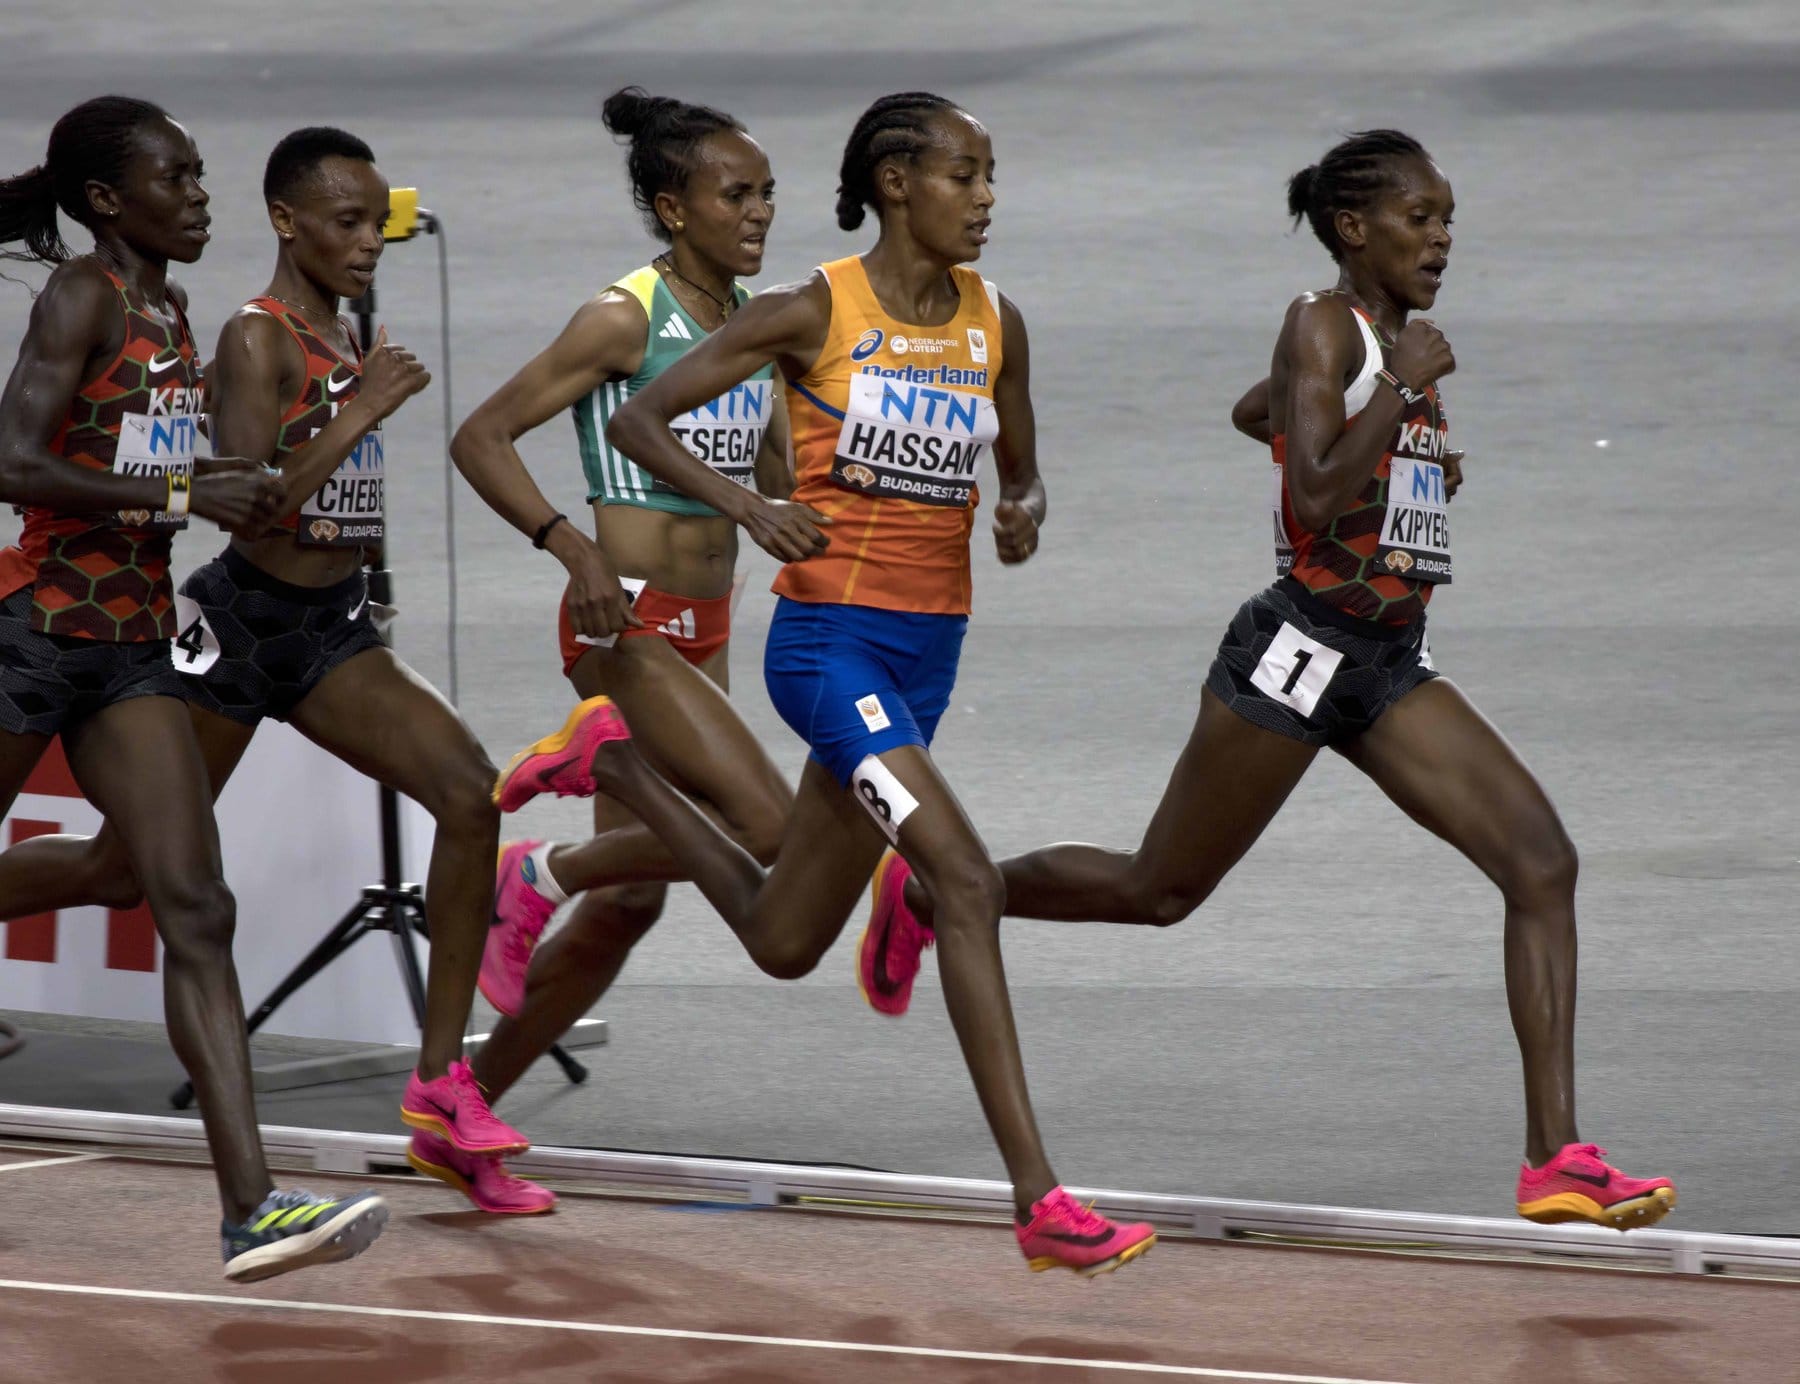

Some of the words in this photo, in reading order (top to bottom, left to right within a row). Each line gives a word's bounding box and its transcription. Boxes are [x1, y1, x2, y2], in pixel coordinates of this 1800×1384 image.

[880, 381, 977, 435] NTN
[848, 422, 982, 475] HASSAN
[176, 616, 203, 664] 4
[1281, 649, 1313, 696] 1
[859, 778, 891, 823] 8
